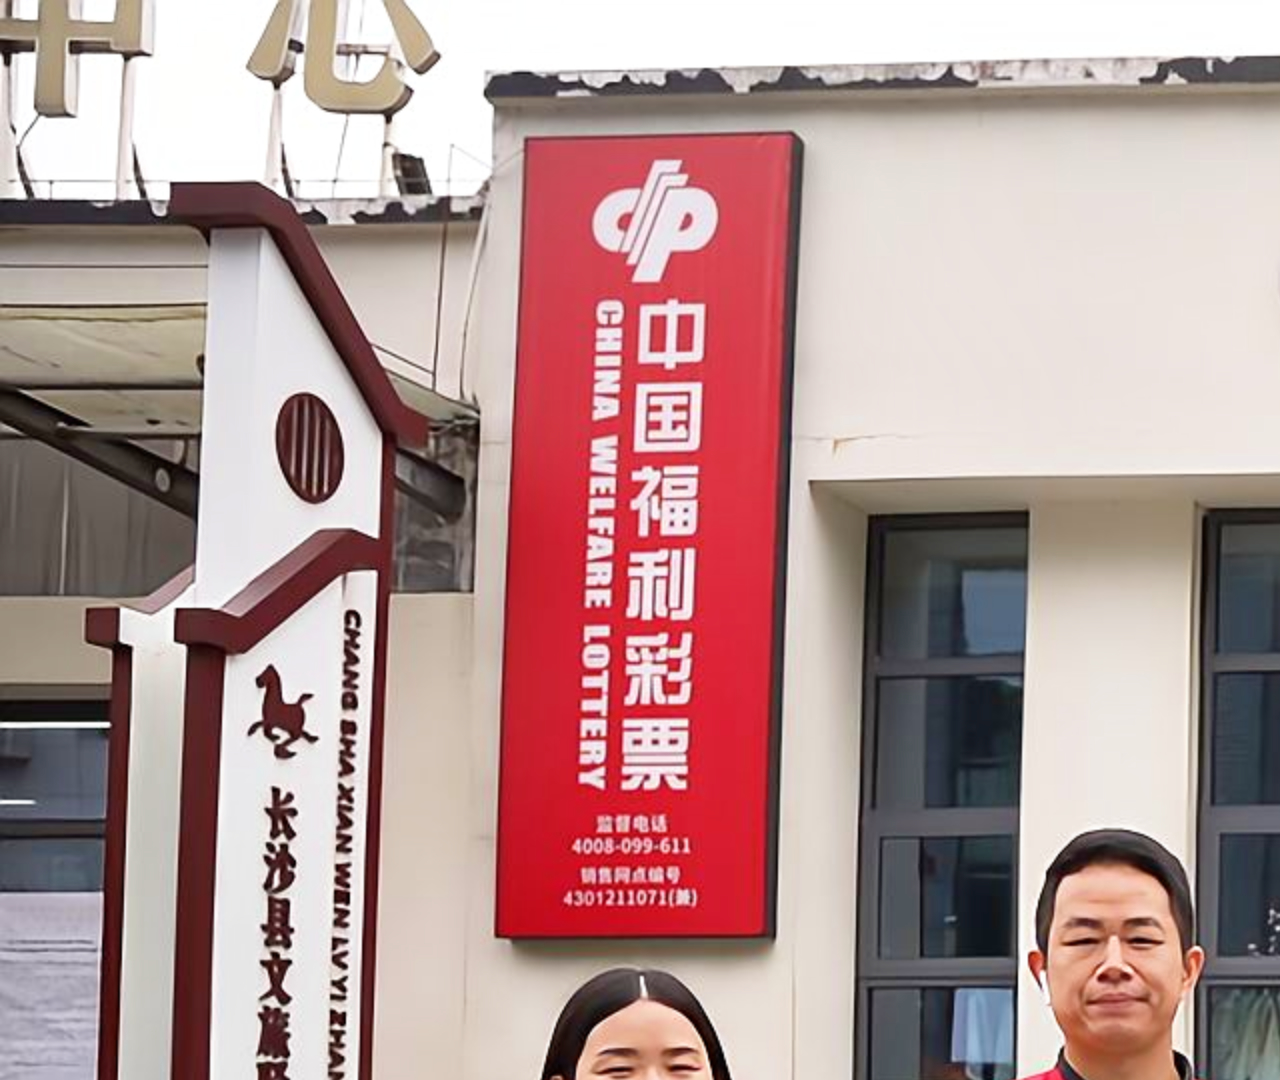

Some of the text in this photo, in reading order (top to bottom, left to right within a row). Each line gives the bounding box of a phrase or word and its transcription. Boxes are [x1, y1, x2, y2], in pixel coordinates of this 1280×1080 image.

[578, 299, 625, 790] CHINA WELFARE LOTTERY
[621, 298, 706, 790] 中国福利彩票
[340, 609, 362, 711] CHANG
[338, 719, 358, 778] SHA
[335, 783, 355, 853] XIAN
[571, 837, 691, 855] 4008-099-611
[596, 814, 668, 833] 监督电话
[333, 862, 352, 928] WEN
